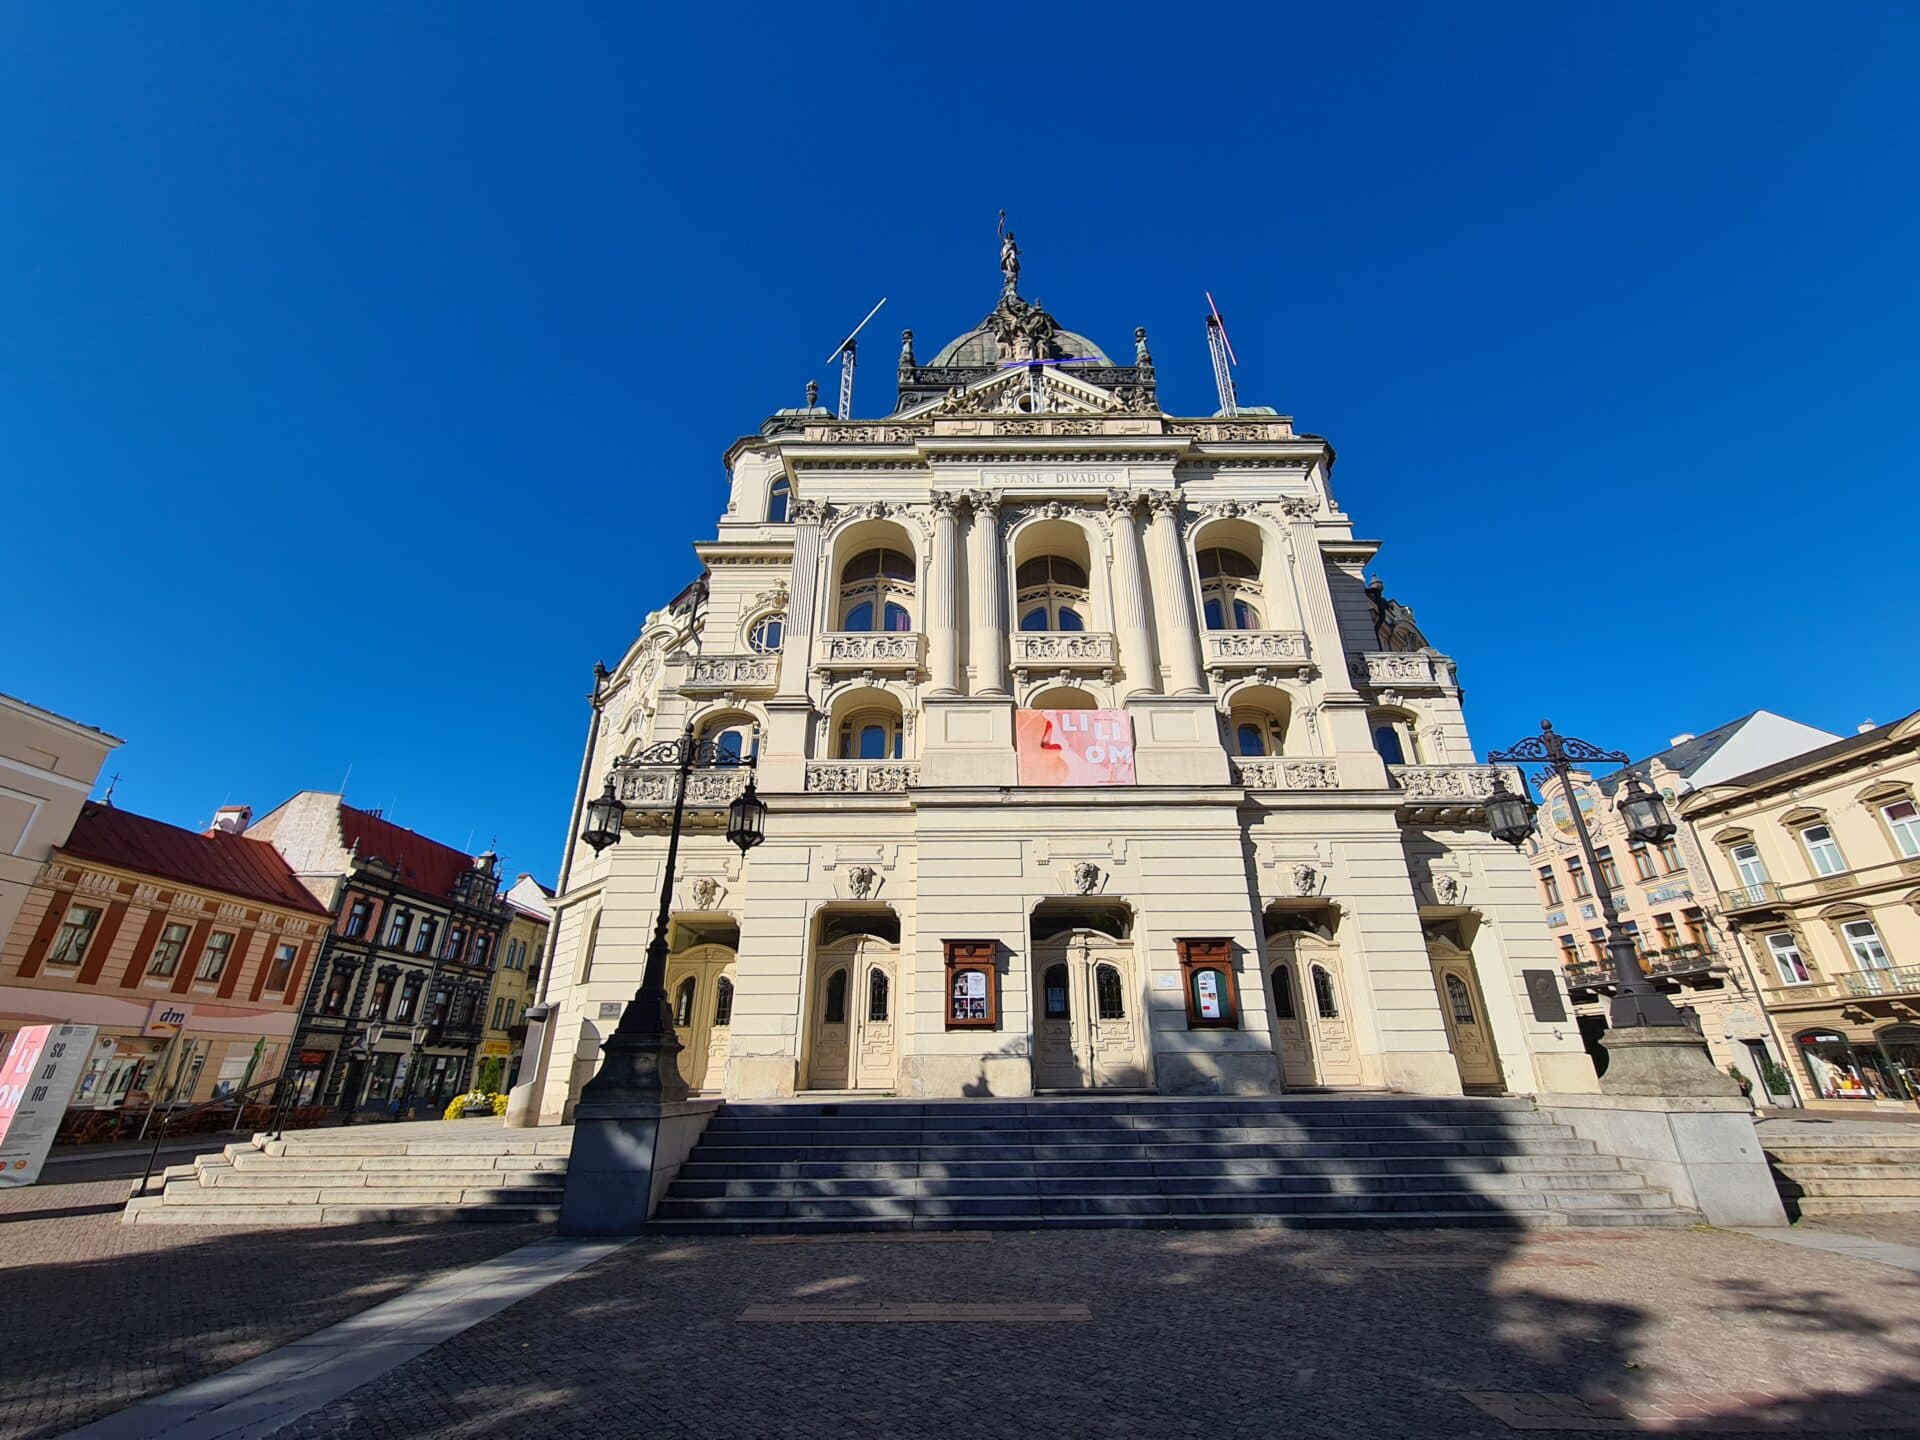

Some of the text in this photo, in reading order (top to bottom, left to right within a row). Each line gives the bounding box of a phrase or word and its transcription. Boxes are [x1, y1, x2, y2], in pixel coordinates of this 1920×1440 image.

[1056, 472, 1116, 484] DIVADLO
[1062, 713, 1089, 732] LI
[1094, 722, 1121, 741] LI
[1085, 745, 1132, 764] OM
[160, 1008, 185, 1024] dm
[50, 1042, 66, 1058] se
[31, 1085, 48, 1102] na
